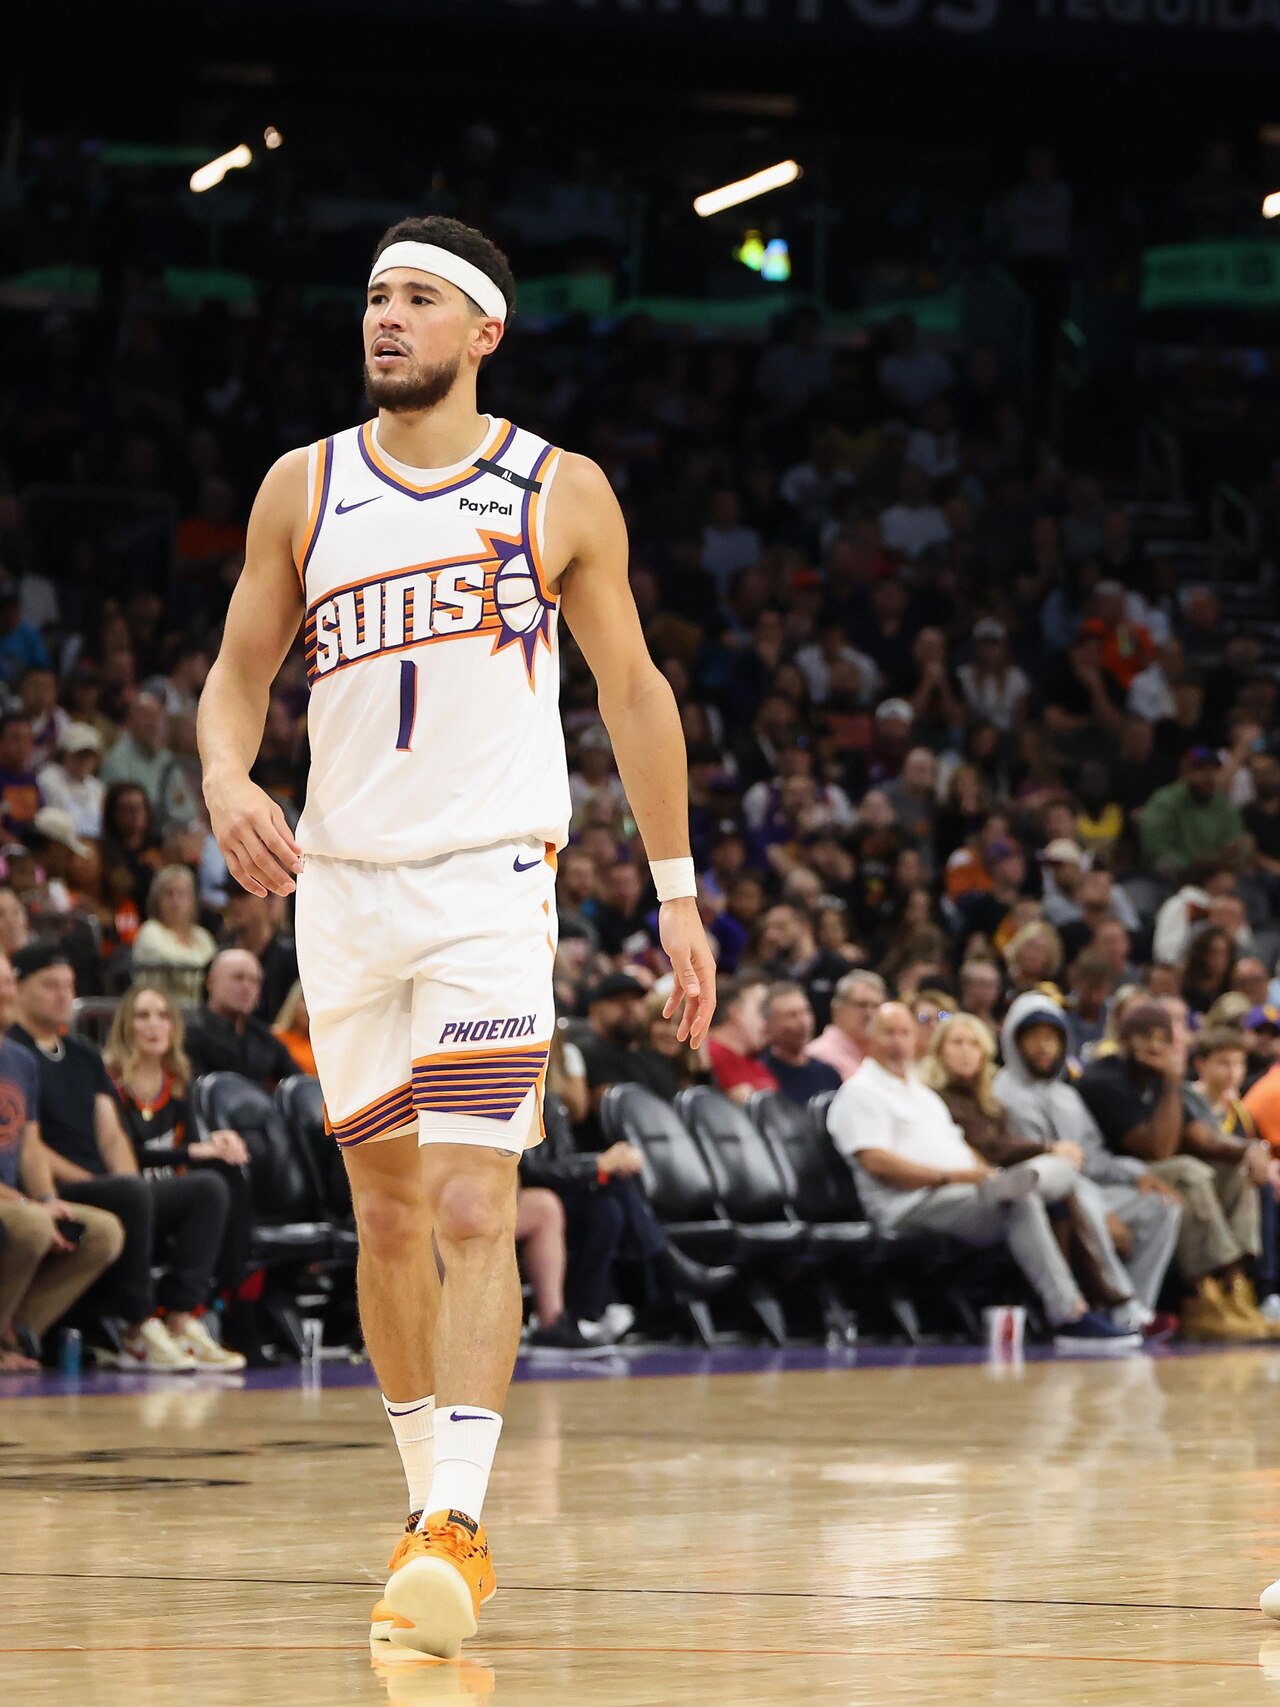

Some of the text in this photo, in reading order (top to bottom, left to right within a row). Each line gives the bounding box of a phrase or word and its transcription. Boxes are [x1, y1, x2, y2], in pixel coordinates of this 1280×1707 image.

[501, 470, 513, 482] AL
[459, 497, 513, 516] PayPal
[315, 563, 485, 674] SUNS
[395, 660, 418, 753] 1
[439, 1014, 537, 1044] PHOENIX
